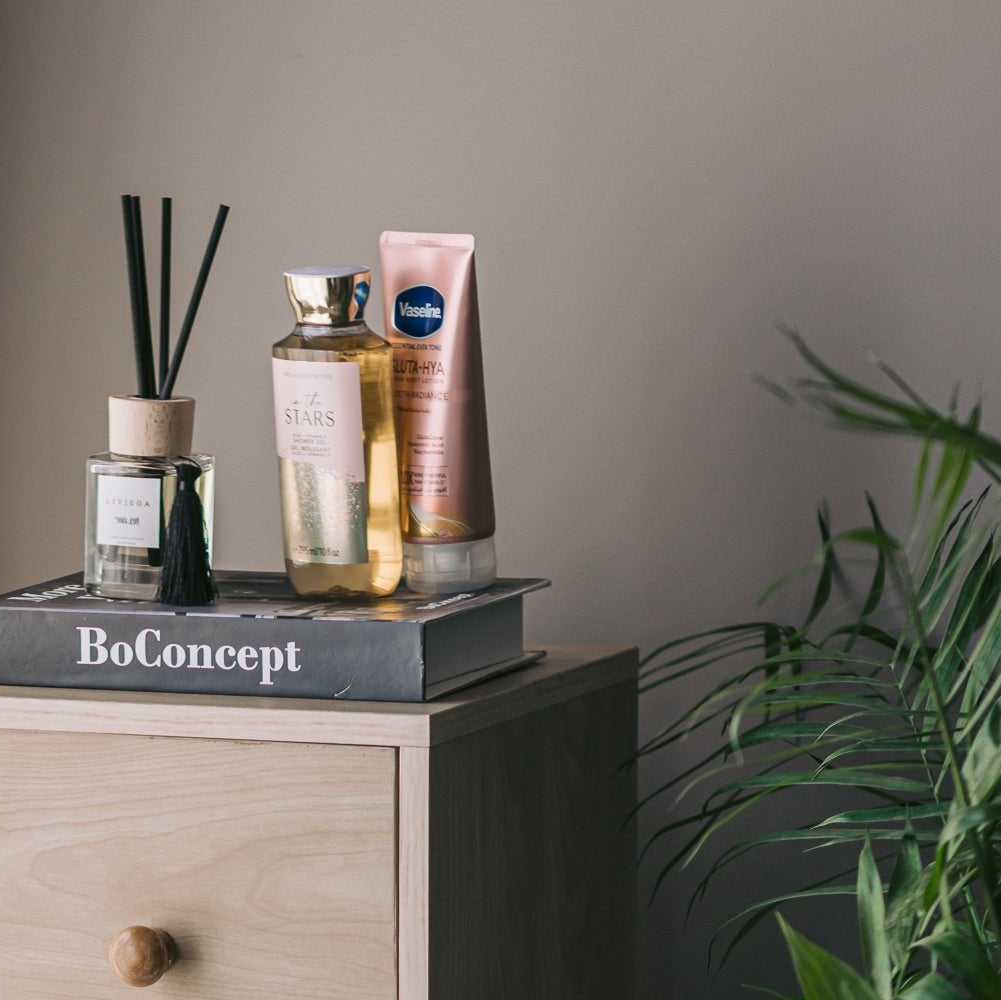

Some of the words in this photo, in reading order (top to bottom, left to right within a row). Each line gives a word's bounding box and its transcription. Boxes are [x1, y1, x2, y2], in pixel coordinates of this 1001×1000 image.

[399, 301, 440, 319] Vaseline
[284, 408, 336, 427] STARS
[76, 626, 302, 685] BoConcept
